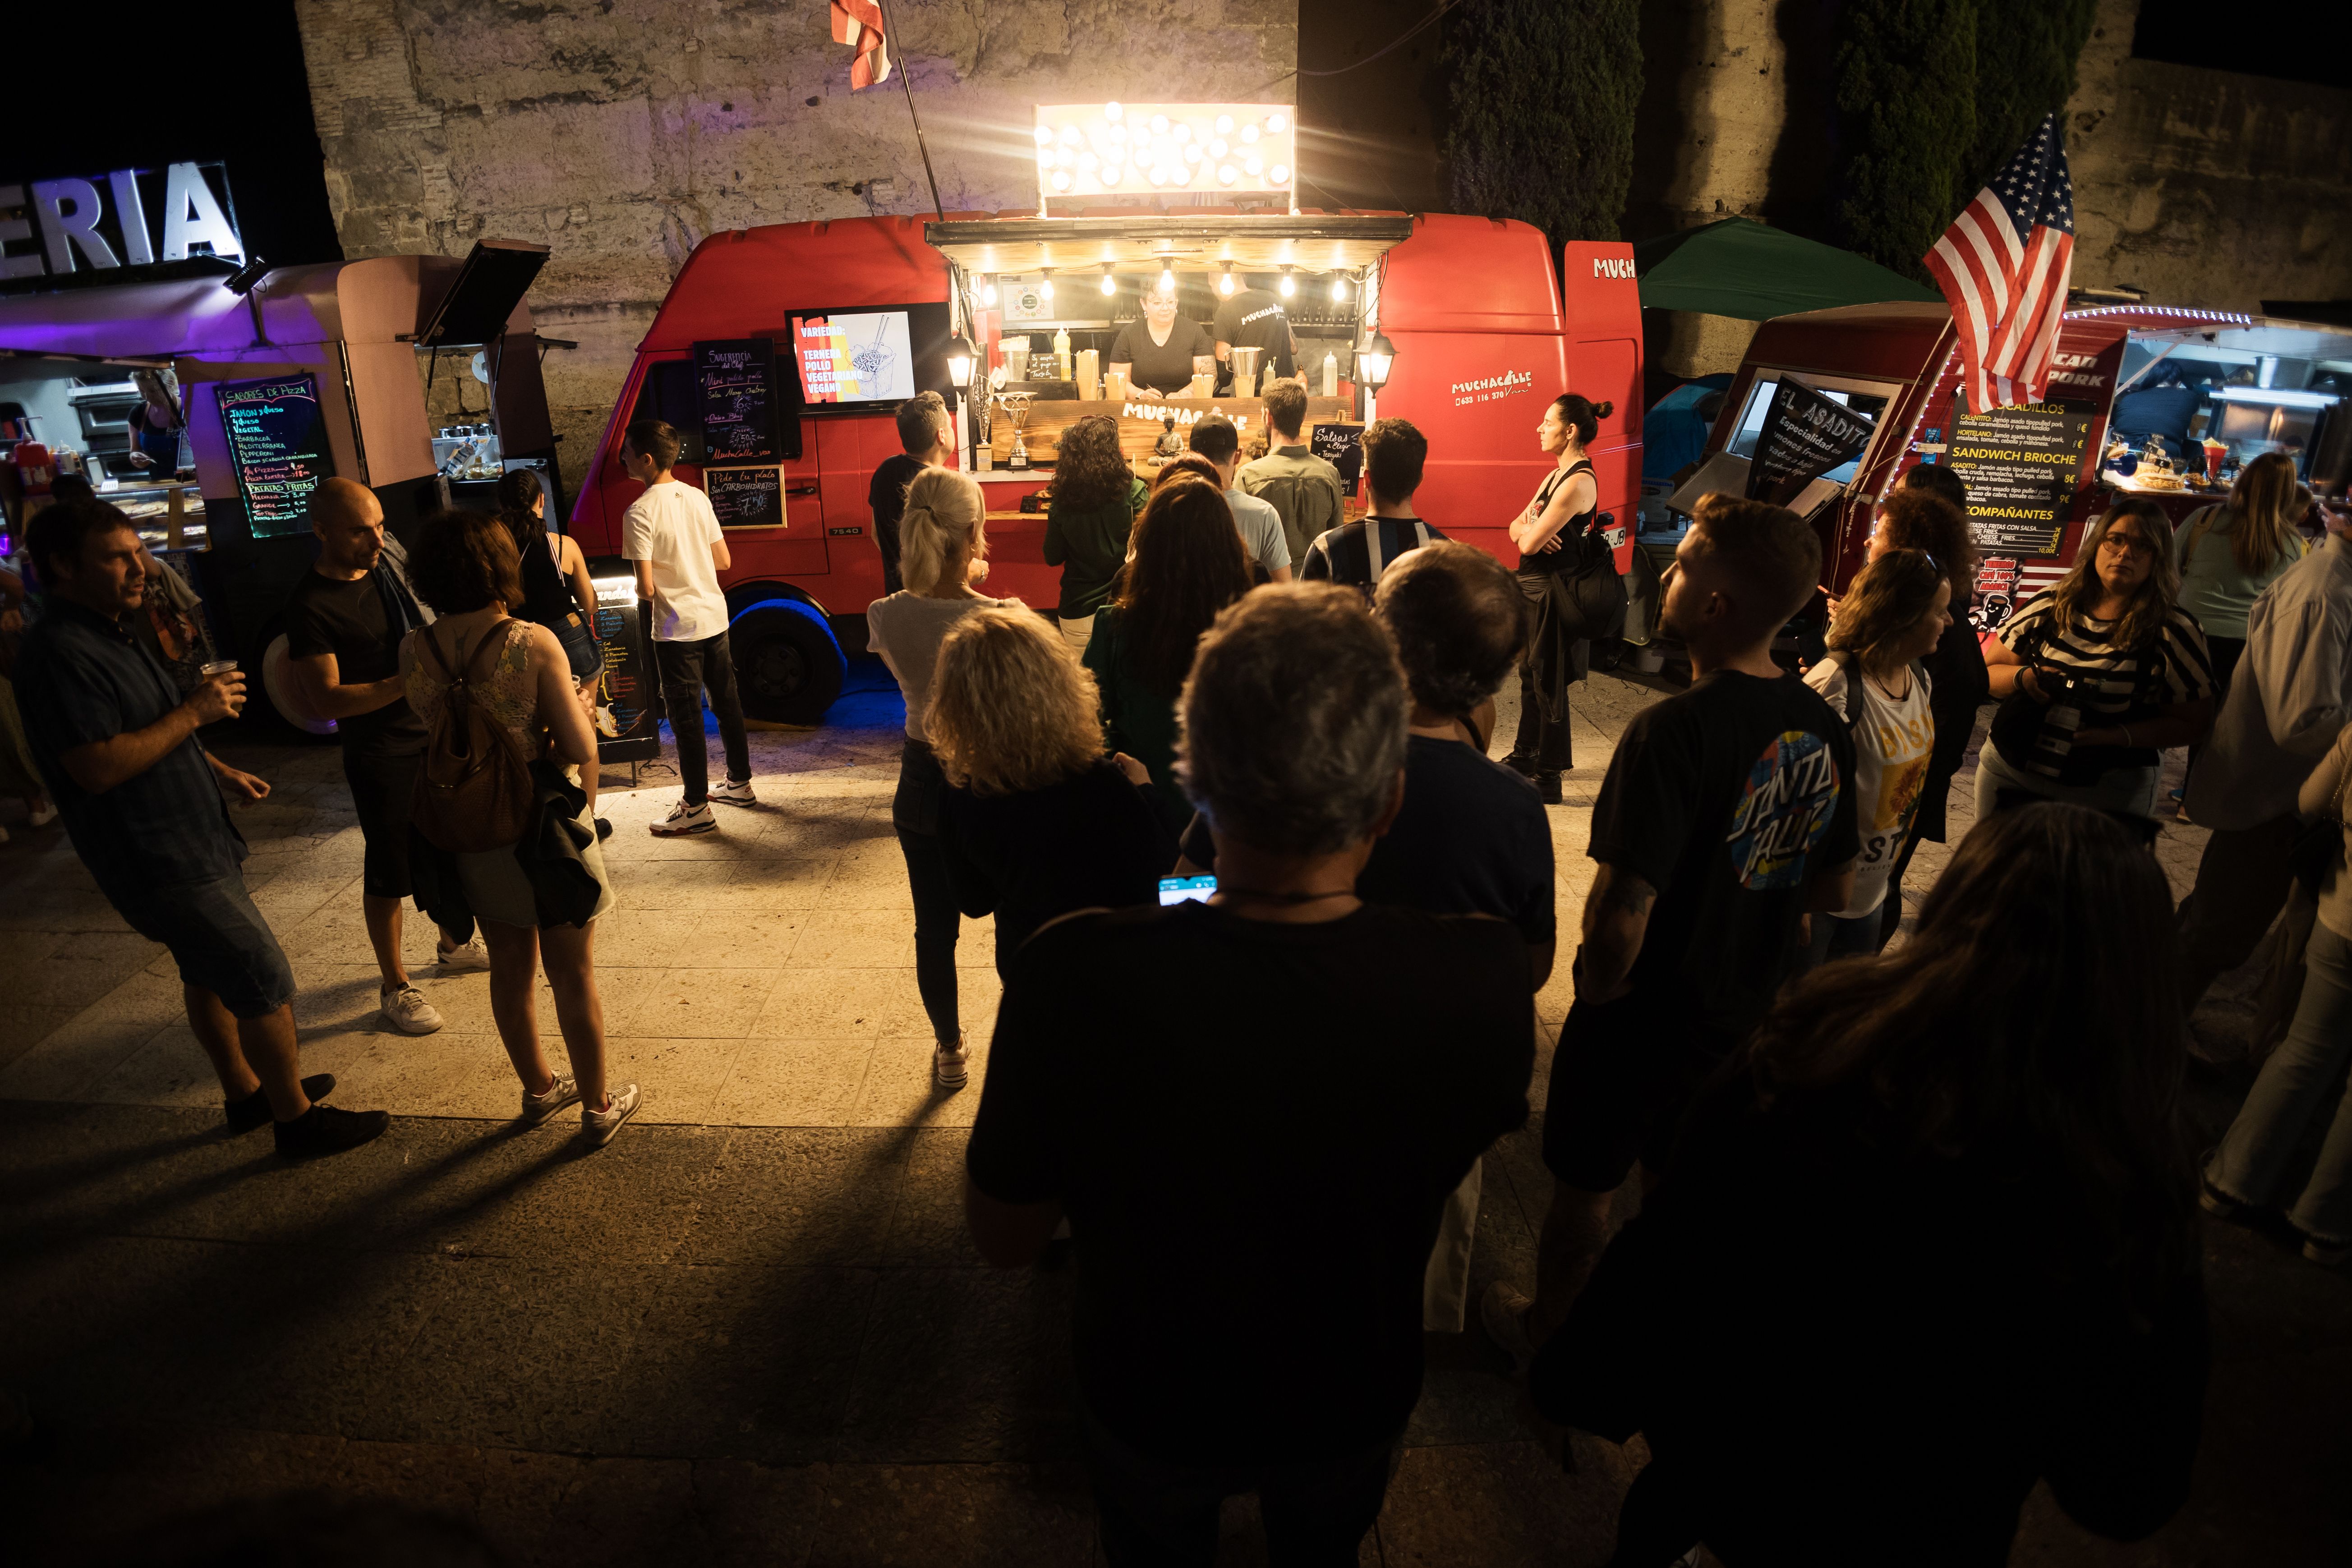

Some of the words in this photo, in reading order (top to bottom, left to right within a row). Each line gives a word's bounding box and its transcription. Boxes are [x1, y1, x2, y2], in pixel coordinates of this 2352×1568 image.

[1593, 258, 1636, 279] MUCH
[801, 326, 846, 338] VARIEDAD:
[803, 349, 841, 360] TERNERA
[805, 361, 831, 371] POLLO
[806, 370, 863, 382] VEGETARIANO
[2048, 371, 2109, 386] PORK
[807, 382, 841, 394] VEGANO
[1505, 385, 1529, 397] Van
[226, 390, 264, 404] SABORES
[267, 388, 279, 397] DE
[280, 385, 306, 395] PIZZA
[708, 391, 721, 399] Salsa
[1461, 396, 1473, 405] 633
[1477, 393, 1489, 402] 116
[1491, 391, 1504, 400] 370
[1780, 387, 1796, 410] EL
[230, 409, 257, 418] JAMON
[1960, 414, 1992, 422] CALENTITO:
[233, 426, 263, 434] VEGETAL
[1314, 428, 1348, 442] Salsas
[1779, 415, 1834, 451] Especialidad
[1957, 429, 1993, 437] HORTELANO:
[1332, 441, 1351, 452] Elegir
[1773, 431, 1803, 452] mones
[1803, 447, 1832, 463] frescos
[1952, 447, 2021, 461] SANDWICH
[2024, 451, 2077, 465] BRIOCHE
[712, 473, 733, 484] Pide
[740, 471, 751, 481] tu
[755, 469, 775, 484] plato
[2064, 474, 2076, 484] 8€
[249, 484, 283, 492] PATATAS
[286, 482, 314, 491] FRITAS
[710, 486, 720, 494] Sin
[721, 482, 778, 492] CARBOHIDRATOS
[2059, 495, 2071, 504] 9€
[1985, 560, 2016, 569] TENEMOS
[1979, 569, 1995, 580] CAFÉ
[1997, 571, 2015, 580] 100%
[1979, 582, 2008, 592] ARABICA
